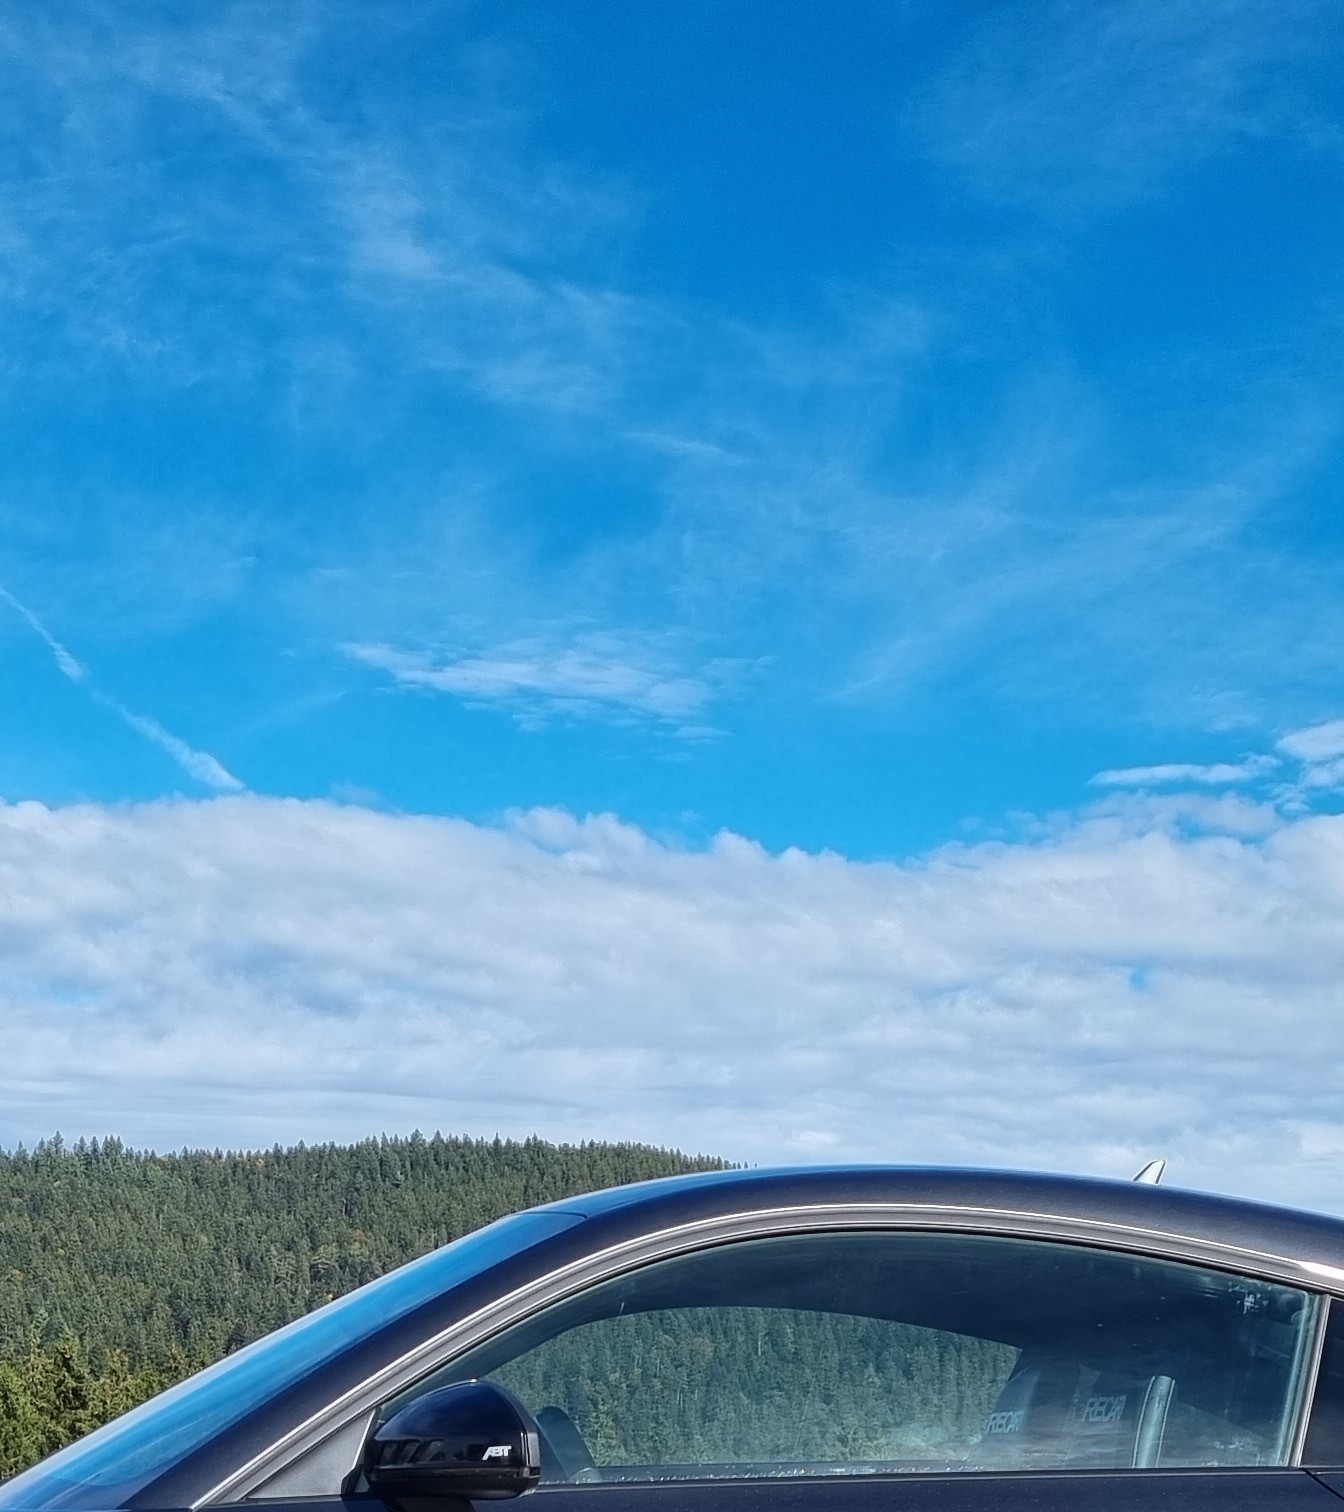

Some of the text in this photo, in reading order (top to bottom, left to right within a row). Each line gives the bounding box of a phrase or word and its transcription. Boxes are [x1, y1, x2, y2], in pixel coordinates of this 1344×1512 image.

[1082, 1394, 1127, 1422] RECAR
[985, 1409, 1025, 1434] RECAR
[482, 1445, 512, 1461] ABT
